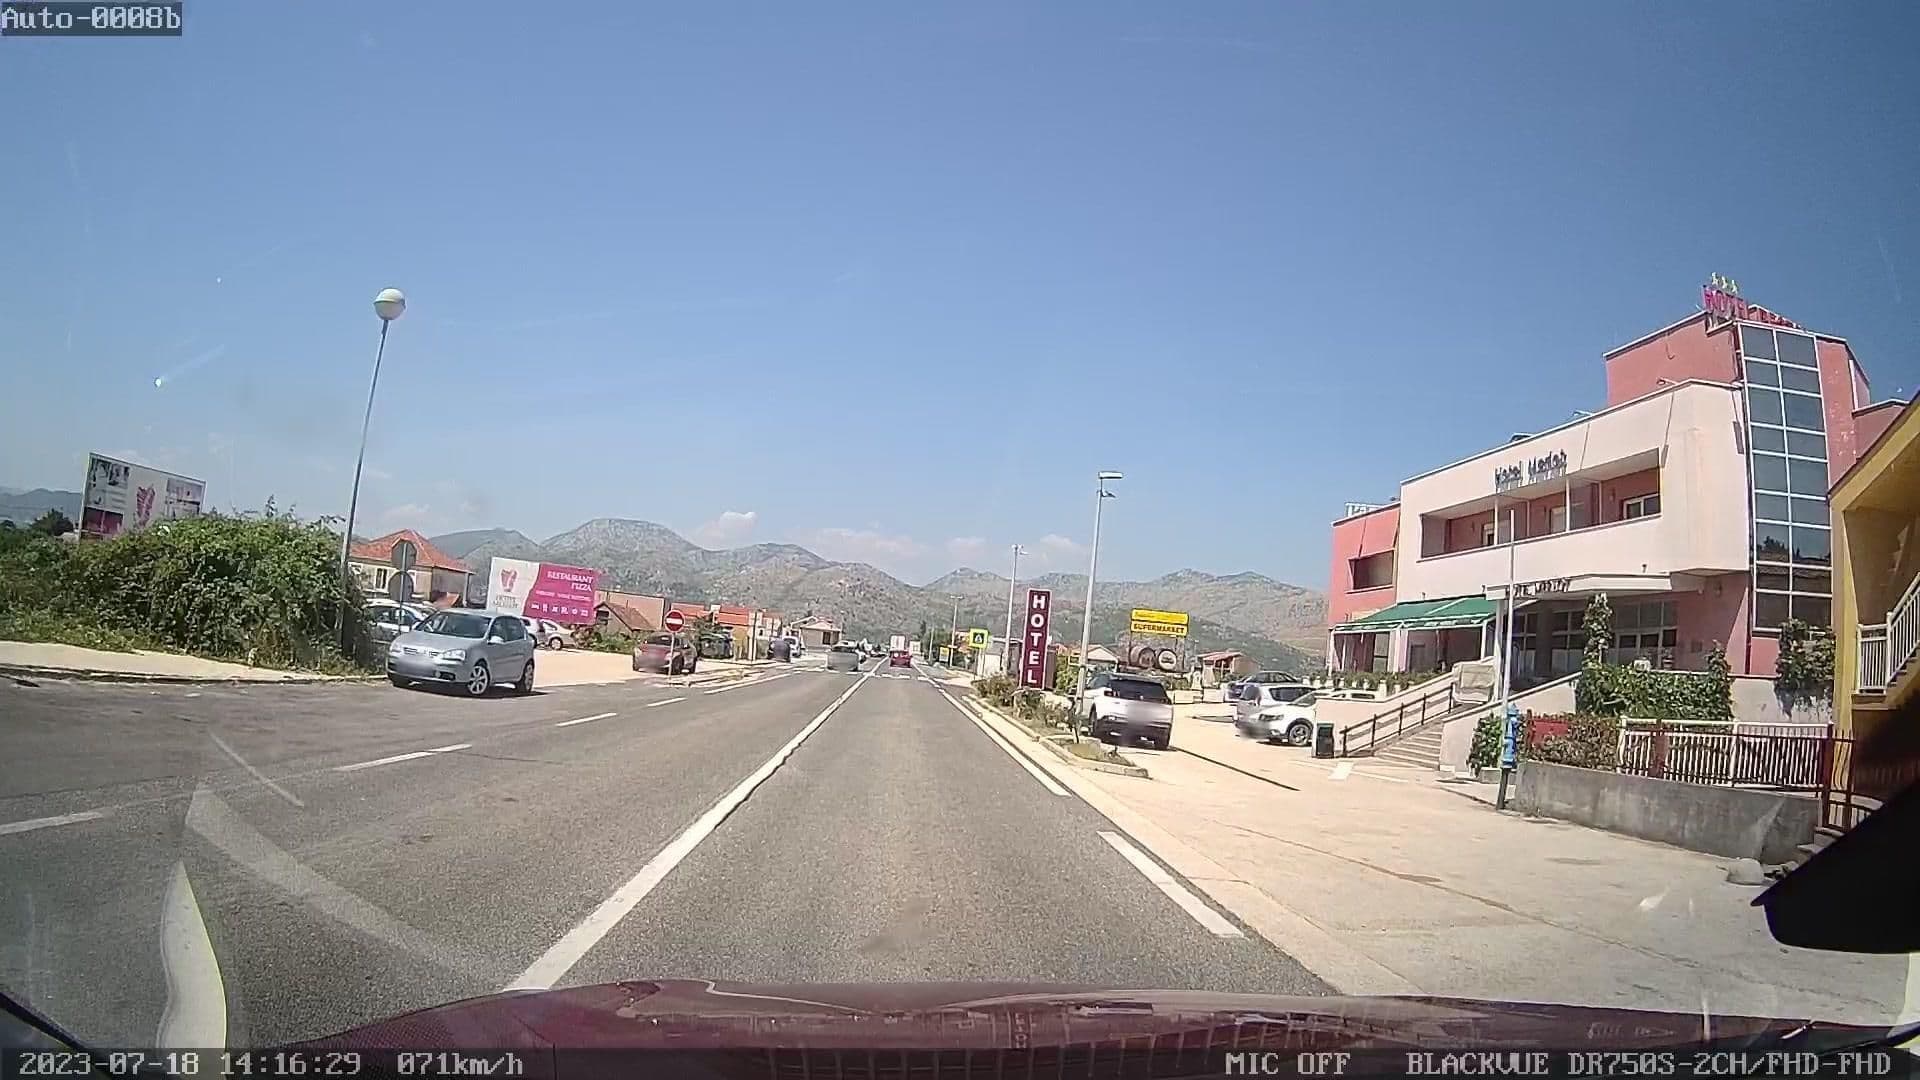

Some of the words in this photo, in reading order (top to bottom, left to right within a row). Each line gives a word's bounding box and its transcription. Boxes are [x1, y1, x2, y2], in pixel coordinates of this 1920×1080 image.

[547, 571, 593, 583] RESTAURANT
[571, 583, 592, 592] PIZZA
[1133, 623, 1185, 634] SUPERMARKET
[1027, 595, 1047, 683] HOTEL
